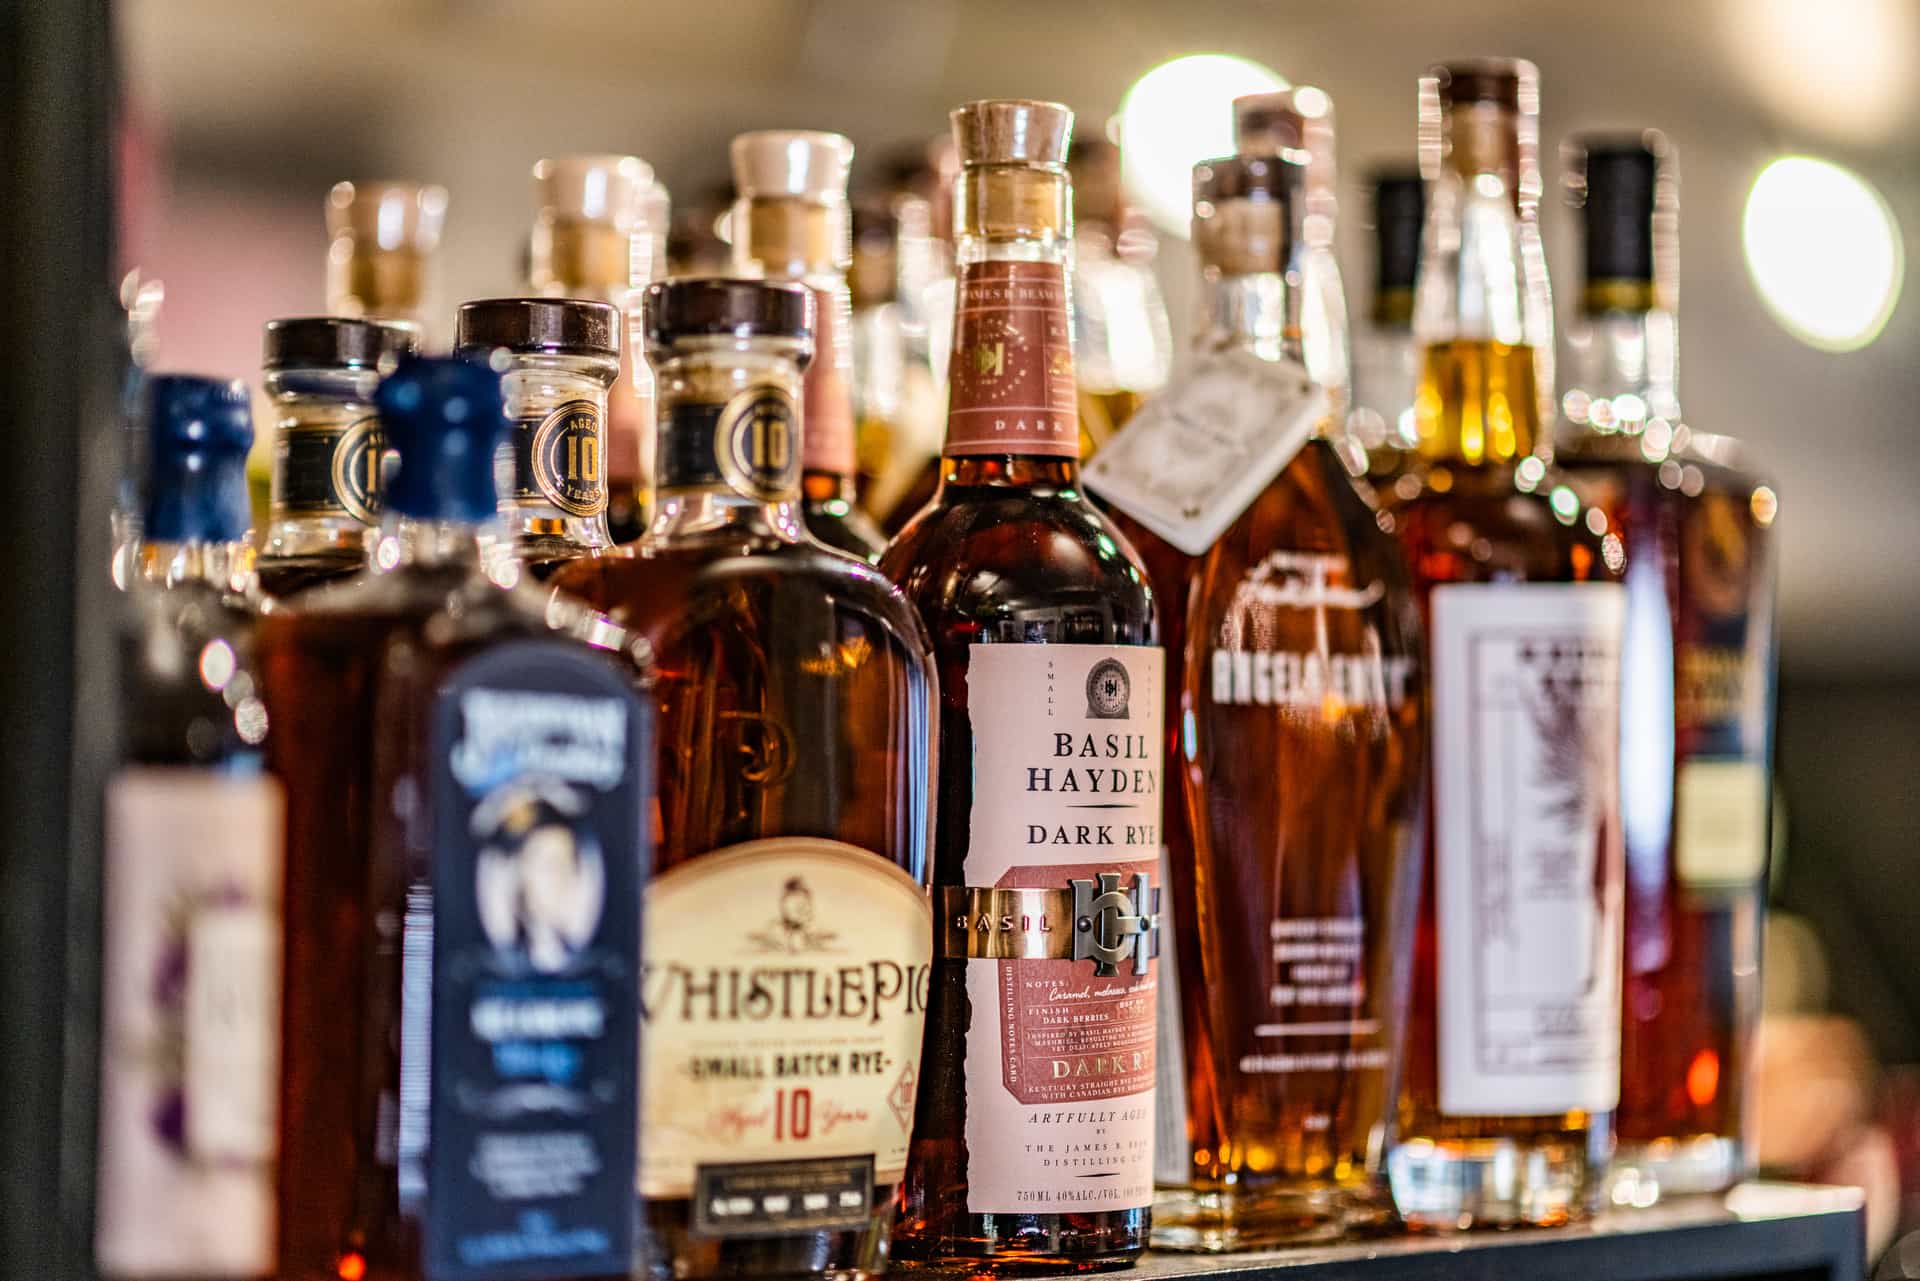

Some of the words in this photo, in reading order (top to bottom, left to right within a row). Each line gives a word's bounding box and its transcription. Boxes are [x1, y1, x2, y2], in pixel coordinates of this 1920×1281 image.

[995, 419, 1063, 432] DARK
[752, 420, 789, 467] 10
[567, 435, 598, 480] 10
[1053, 732, 1148, 759] BASIL
[1027, 824, 1115, 845] DARK
[1125, 823, 1155, 845] RYE
[956, 913, 1051, 932] BASIL
[1042, 1016, 1070, 1025] DARK
[775, 1051, 841, 1078] BATCH
[1052, 1054, 1127, 1079] DARK
[775, 1087, 812, 1142] 10
[1028, 1111, 1116, 1124] ARTFULLY
[1025, 1144, 1055, 1153] THE
[1065, 1143, 1109, 1154] JAMES
[1017, 1189, 1052, 1202] 750ML
